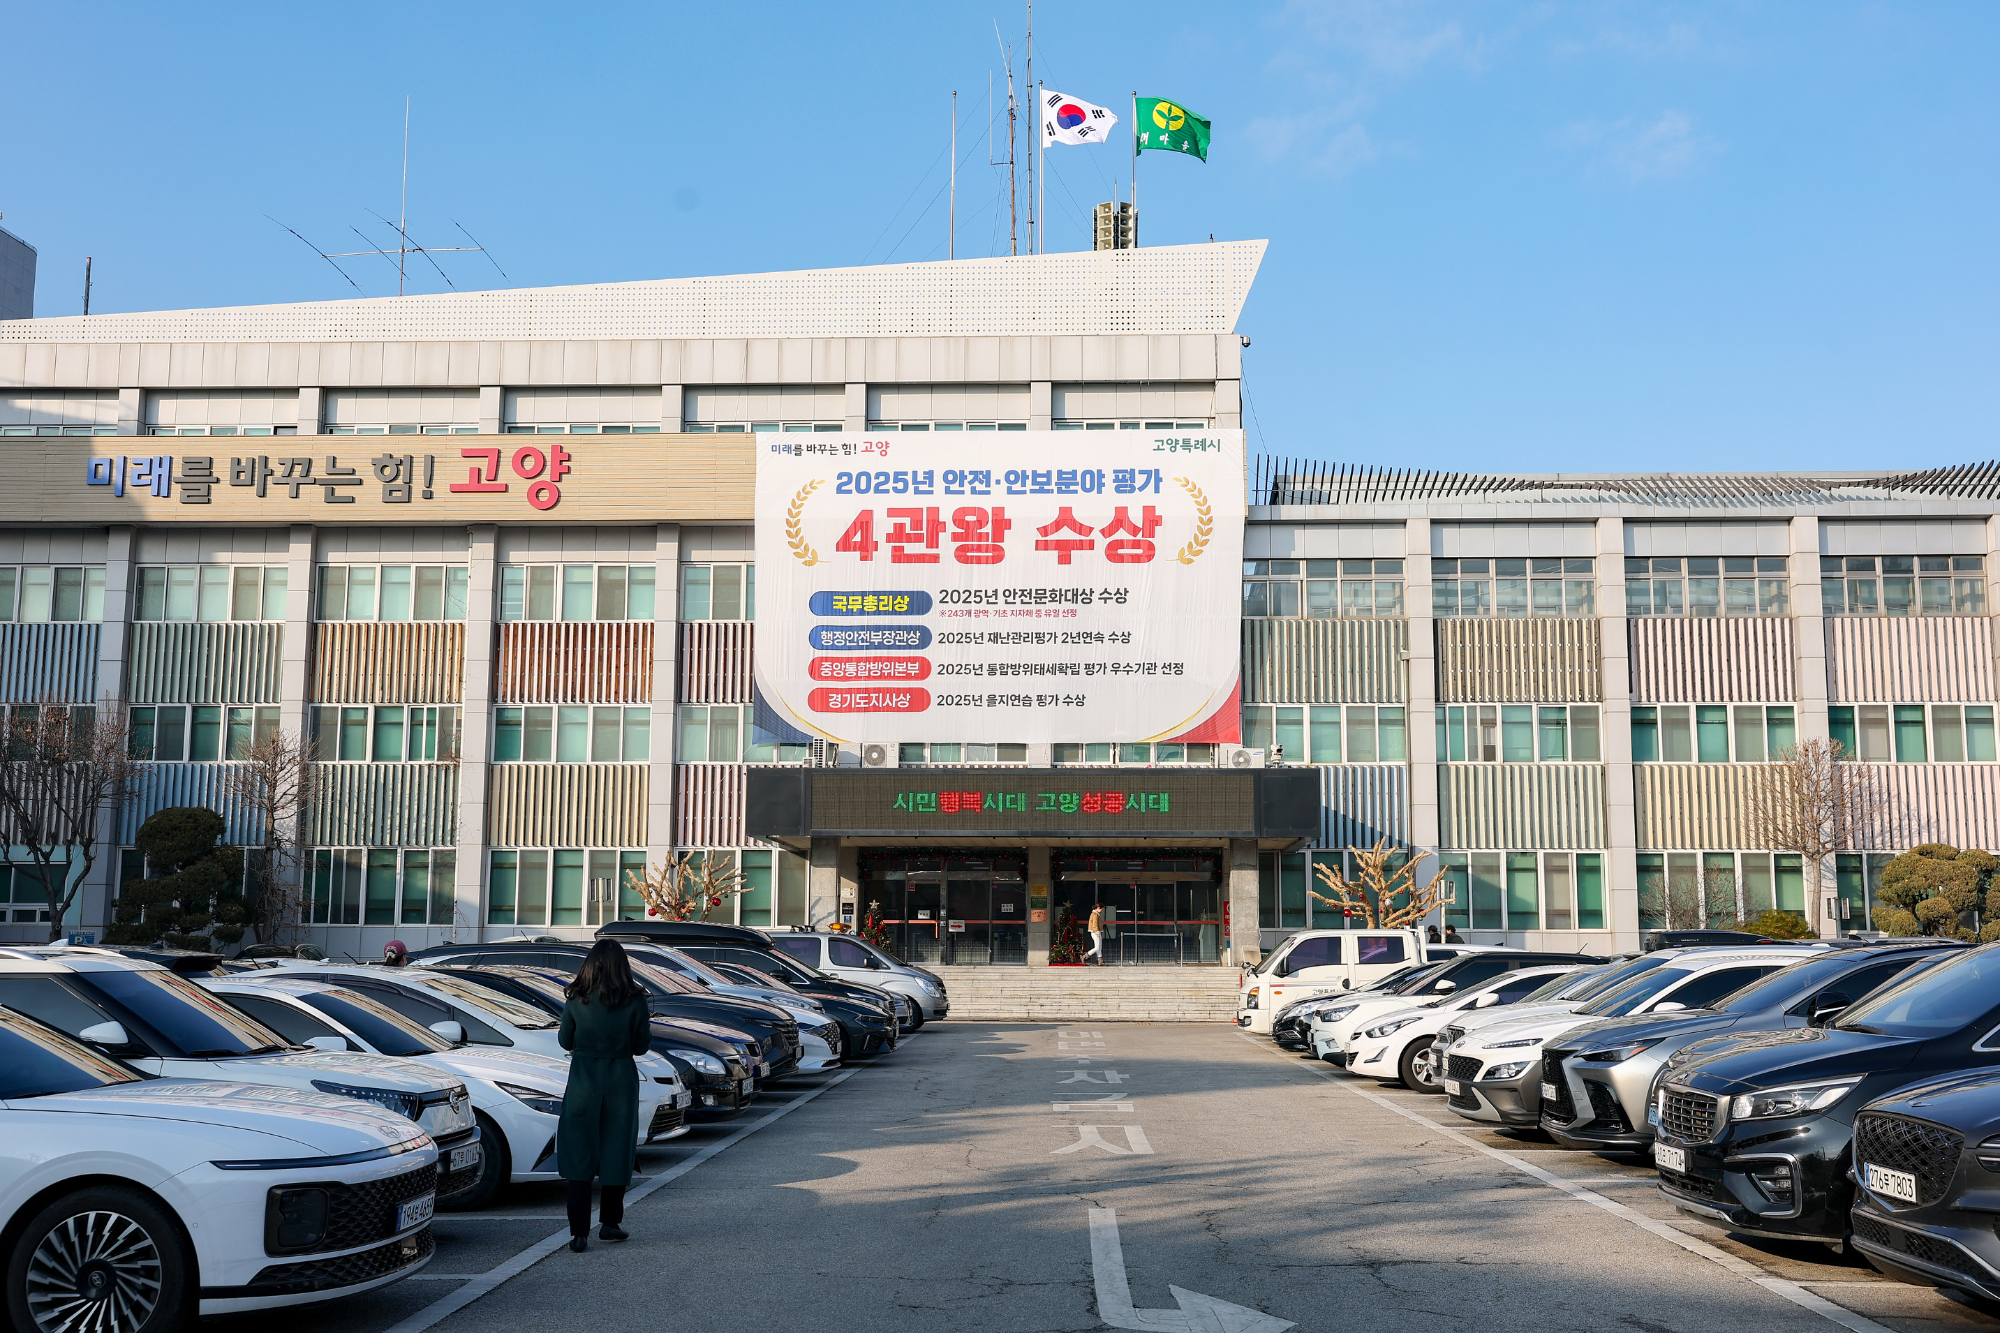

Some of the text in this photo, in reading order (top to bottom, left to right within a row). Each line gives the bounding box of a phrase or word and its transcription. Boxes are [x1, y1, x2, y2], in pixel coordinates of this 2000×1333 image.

[771, 440, 890, 457] 미래를 바꾸는 힘! 고양
[1152, 438, 1221, 453] 고양특례시
[86, 444, 571, 511] 미래를 바꾸는 힘! 고양
[836, 470, 934, 495] 2025년
[1112, 468, 1163, 494] 평가
[835, 505, 1163, 565] 4관왕 수상
[832, 595, 910, 612] 국무총리상
[938, 588, 1129, 605] 2025년 안전문화대상 수상
[1009, 609, 1033, 618] 지자체
[1034, 609, 1042, 618] 중
[1044, 609, 1060, 618] 유일
[1061, 609, 1077, 618] 선정
[820, 630, 921, 646] 행정안전부장관상
[938, 631, 1132, 645] 2025년 재난관리평가 2년연속 수상
[820, 661, 920, 677] 중앙통합방위본부
[937, 662, 1184, 676] 2025년 통합방위태세확립 평가 우수기관 선정
[828, 693, 911, 708] 경기도지사상
[936, 694, 1086, 707] 2025년 을지연습 평가 수상
[893, 790, 1170, 814] 시민행복시대 고양성공시대
[1890, 1173, 1914, 1198] 7803
